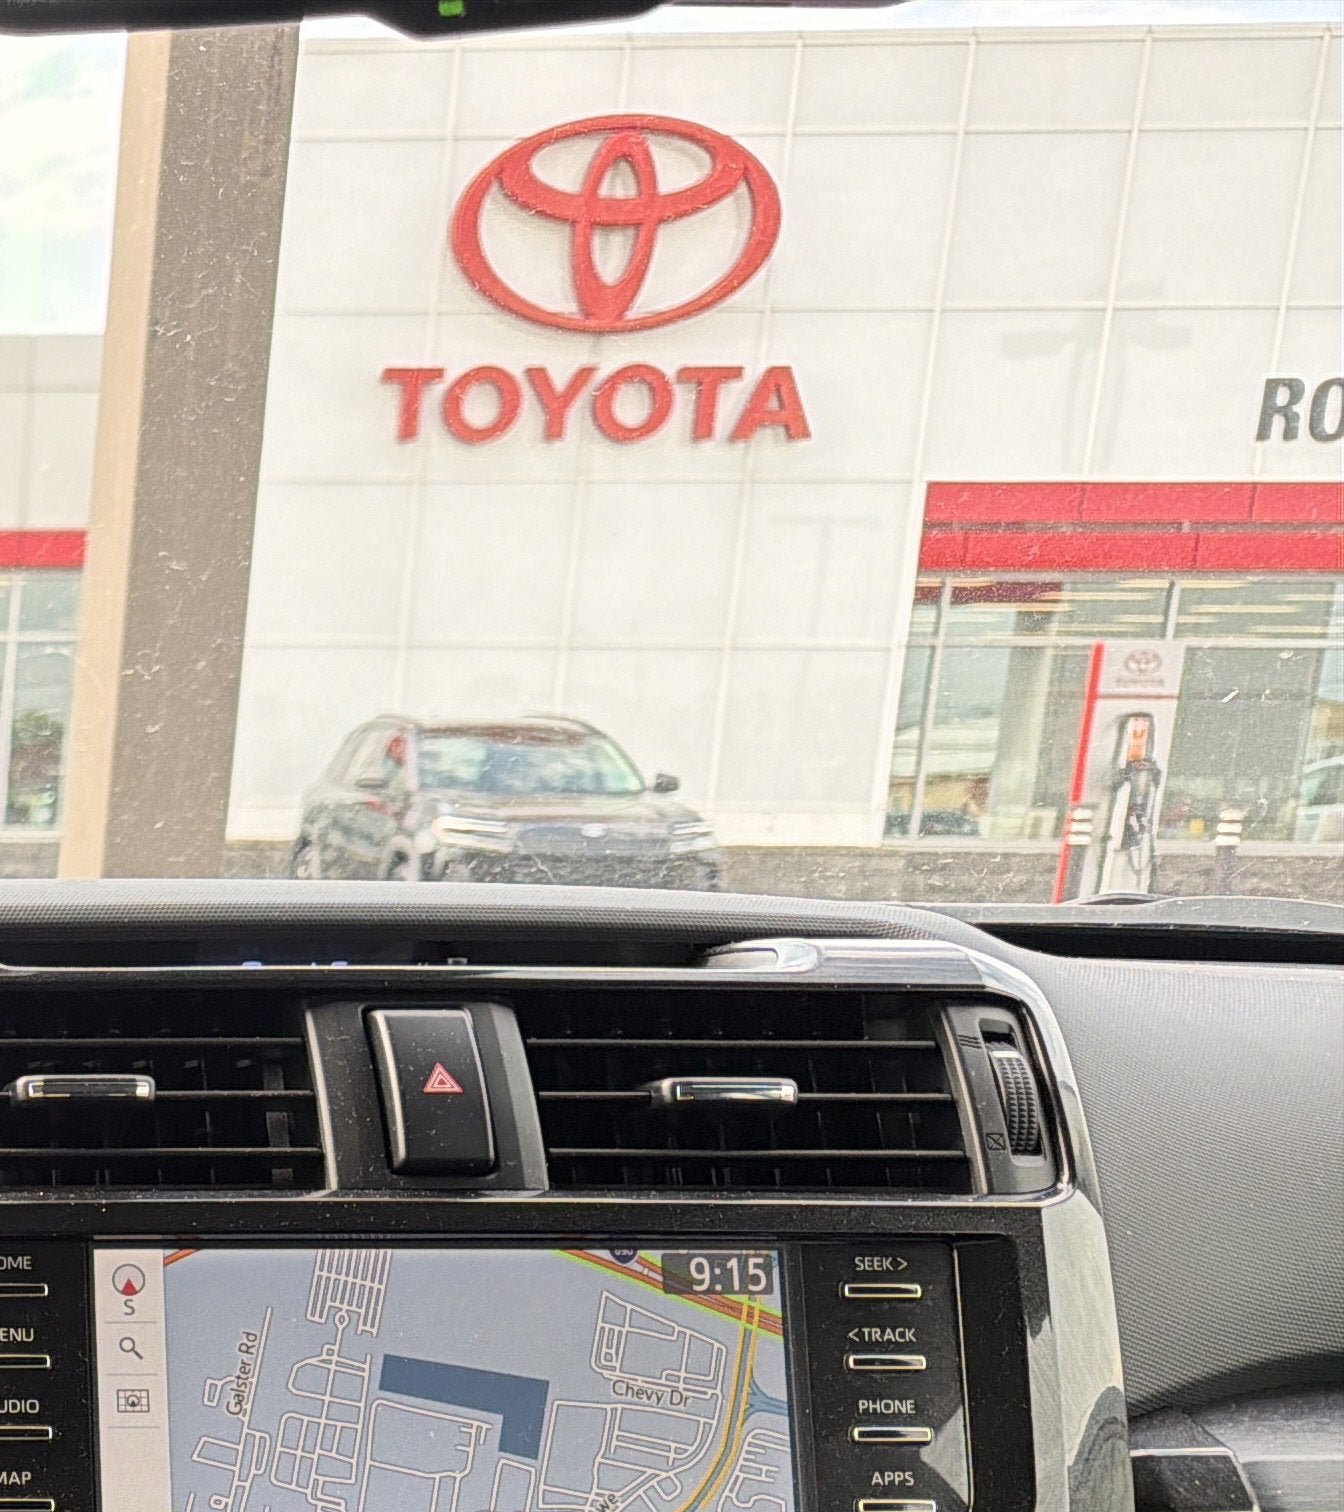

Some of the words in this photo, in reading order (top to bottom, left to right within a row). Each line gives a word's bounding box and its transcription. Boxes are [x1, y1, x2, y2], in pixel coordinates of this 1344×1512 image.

[380, 363, 812, 445] TOYOTA
[689, 1256, 767, 1292] 9:15
[124, 1299, 136, 1316] S
[238, 1331, 258, 1356] Rd
[226, 1359, 252, 1416] Galster
[611, 1380, 662, 1407] Chevy
[667, 1389, 691, 1408] Dr
[858, 1398, 916, 1415] PHONE
[871, 1470, 914, 1487] APPS
